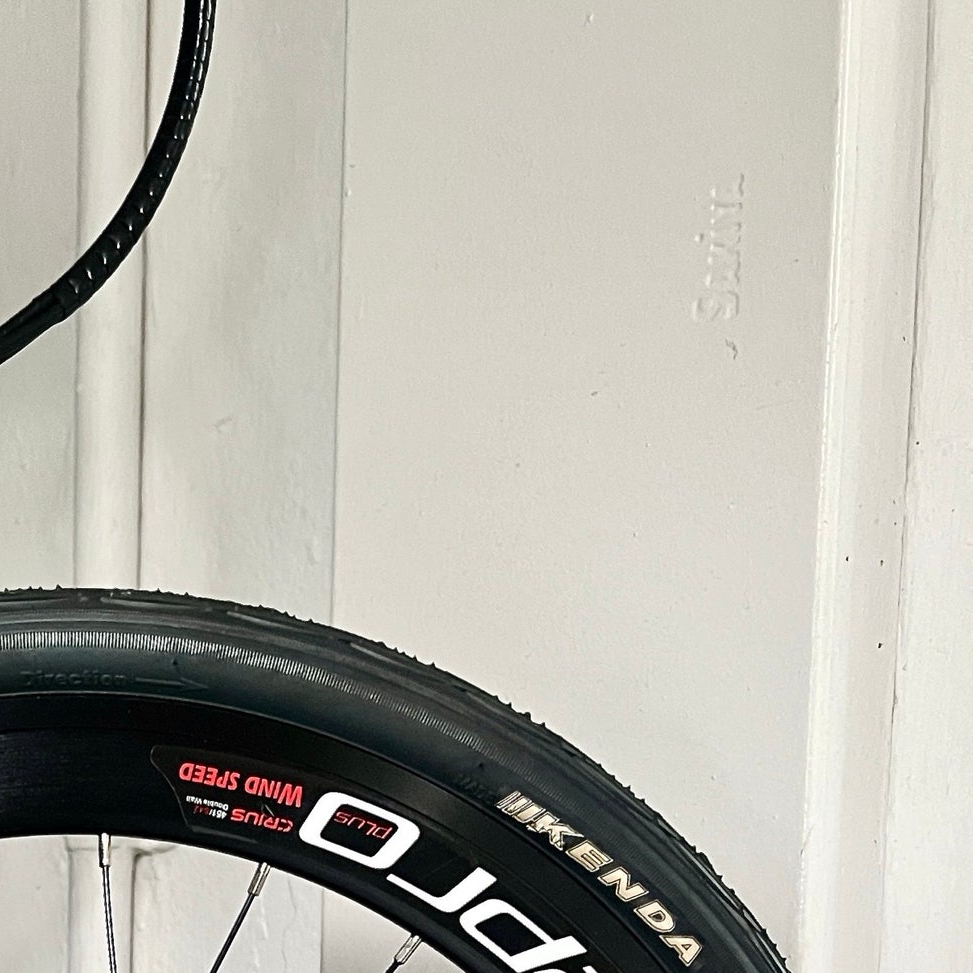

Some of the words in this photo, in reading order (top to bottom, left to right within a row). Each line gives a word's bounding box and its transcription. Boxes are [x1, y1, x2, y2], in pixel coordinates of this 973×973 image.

[178, 762, 241, 791] SPEED
[244, 776, 303, 808] WIND
[230, 808, 294, 832] CRIUS
[524, 808, 705, 967] KENDA
